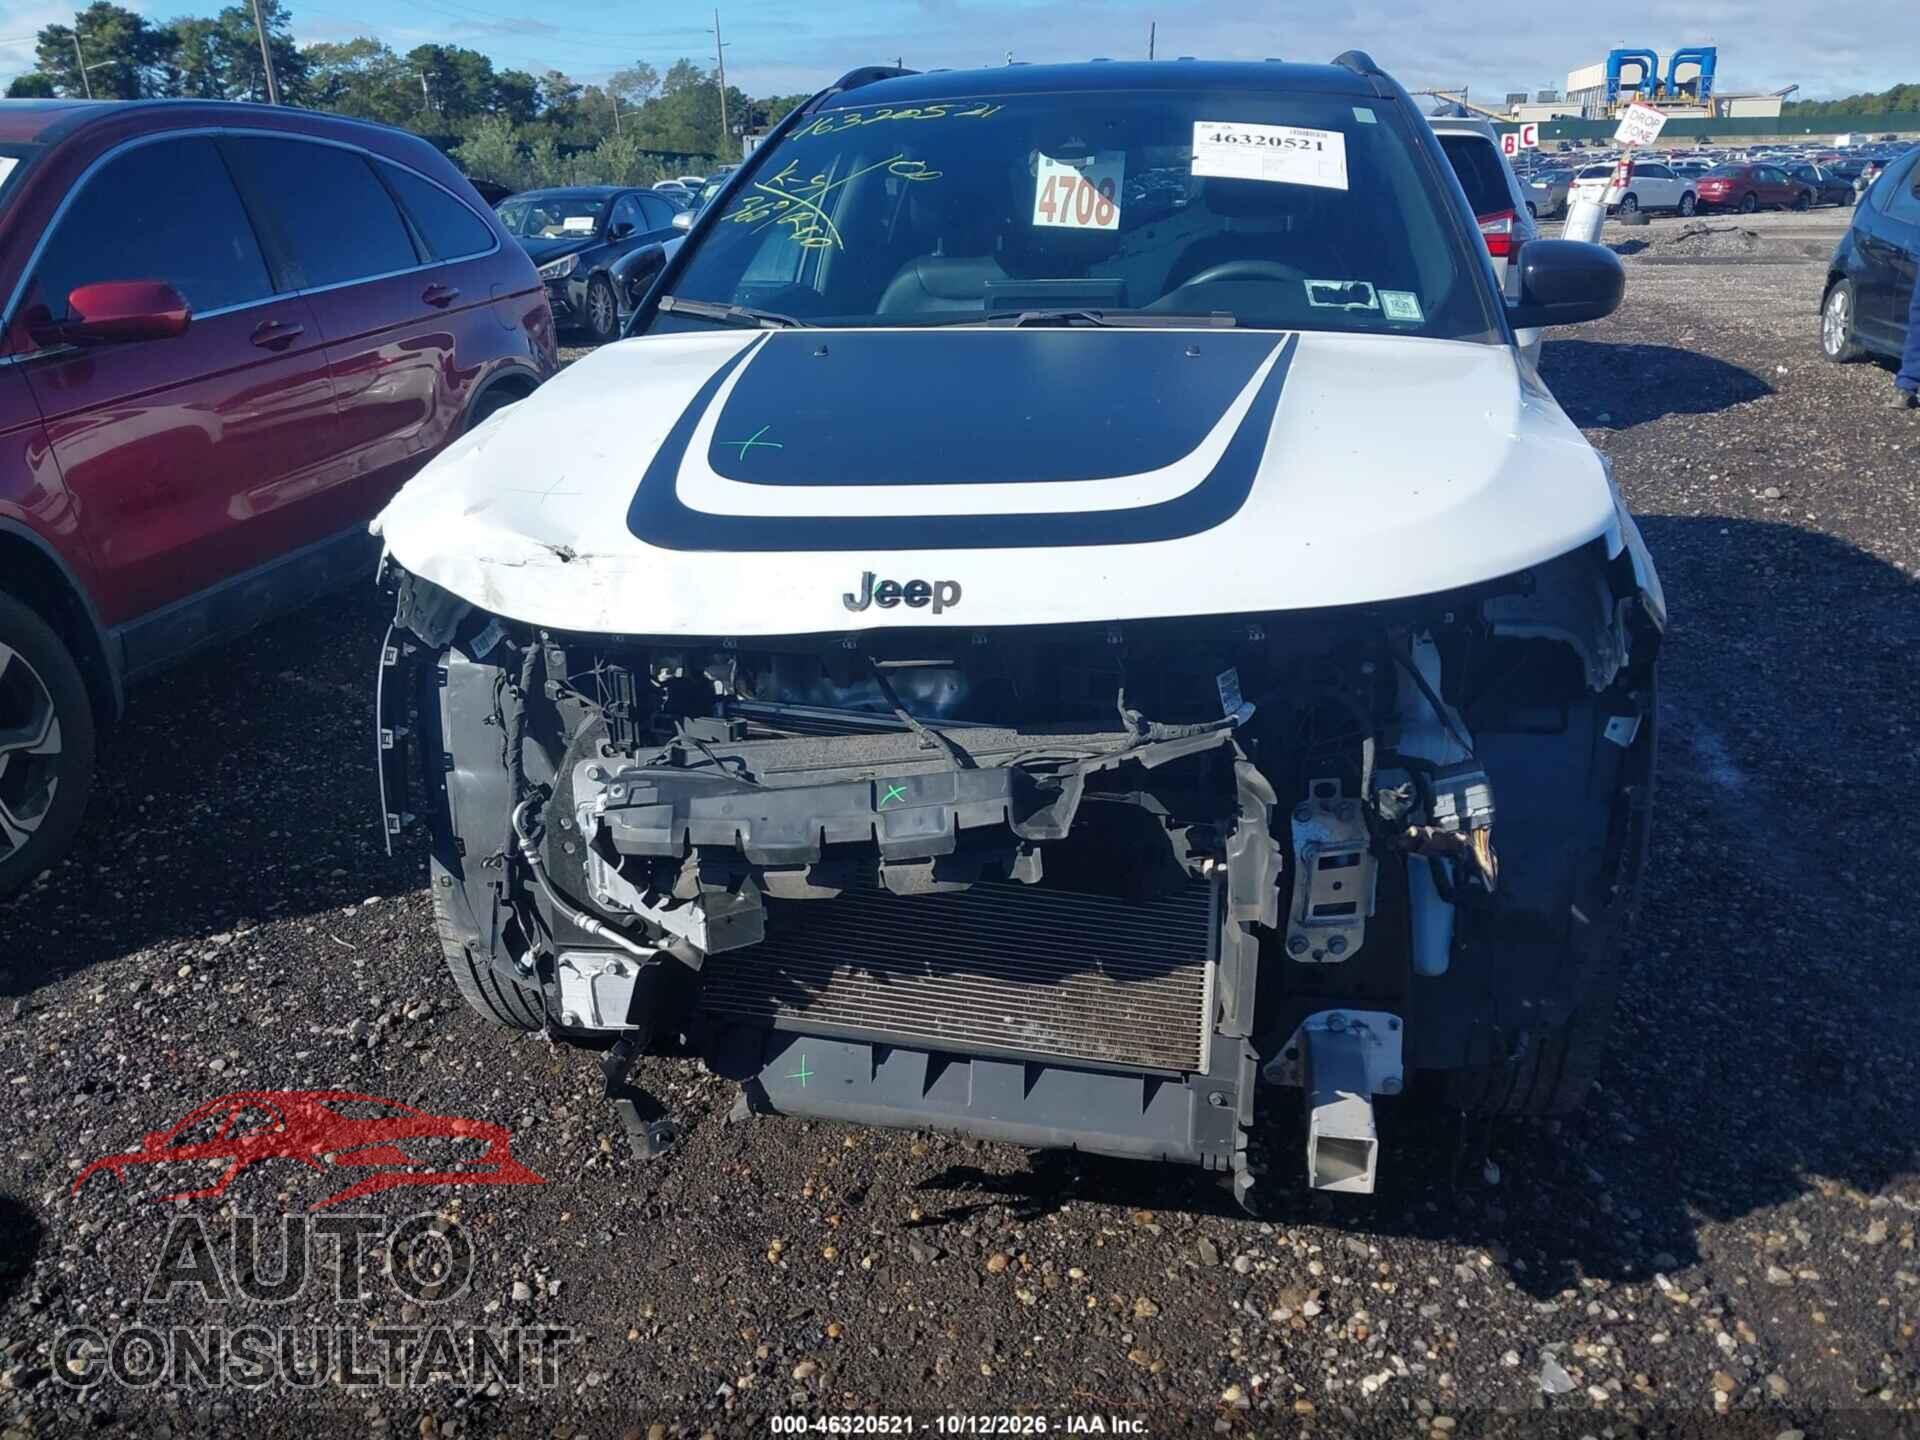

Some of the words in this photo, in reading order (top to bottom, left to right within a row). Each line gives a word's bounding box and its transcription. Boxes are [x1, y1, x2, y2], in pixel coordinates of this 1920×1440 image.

[1629, 110, 1660, 127] DROP
[1209, 132, 1324, 152] 46320521
[1523, 126, 1535, 145] C
[1504, 136, 1515, 155] B
[1038, 175, 1116, 226] 4708
[843, 571, 962, 615] Jeep
